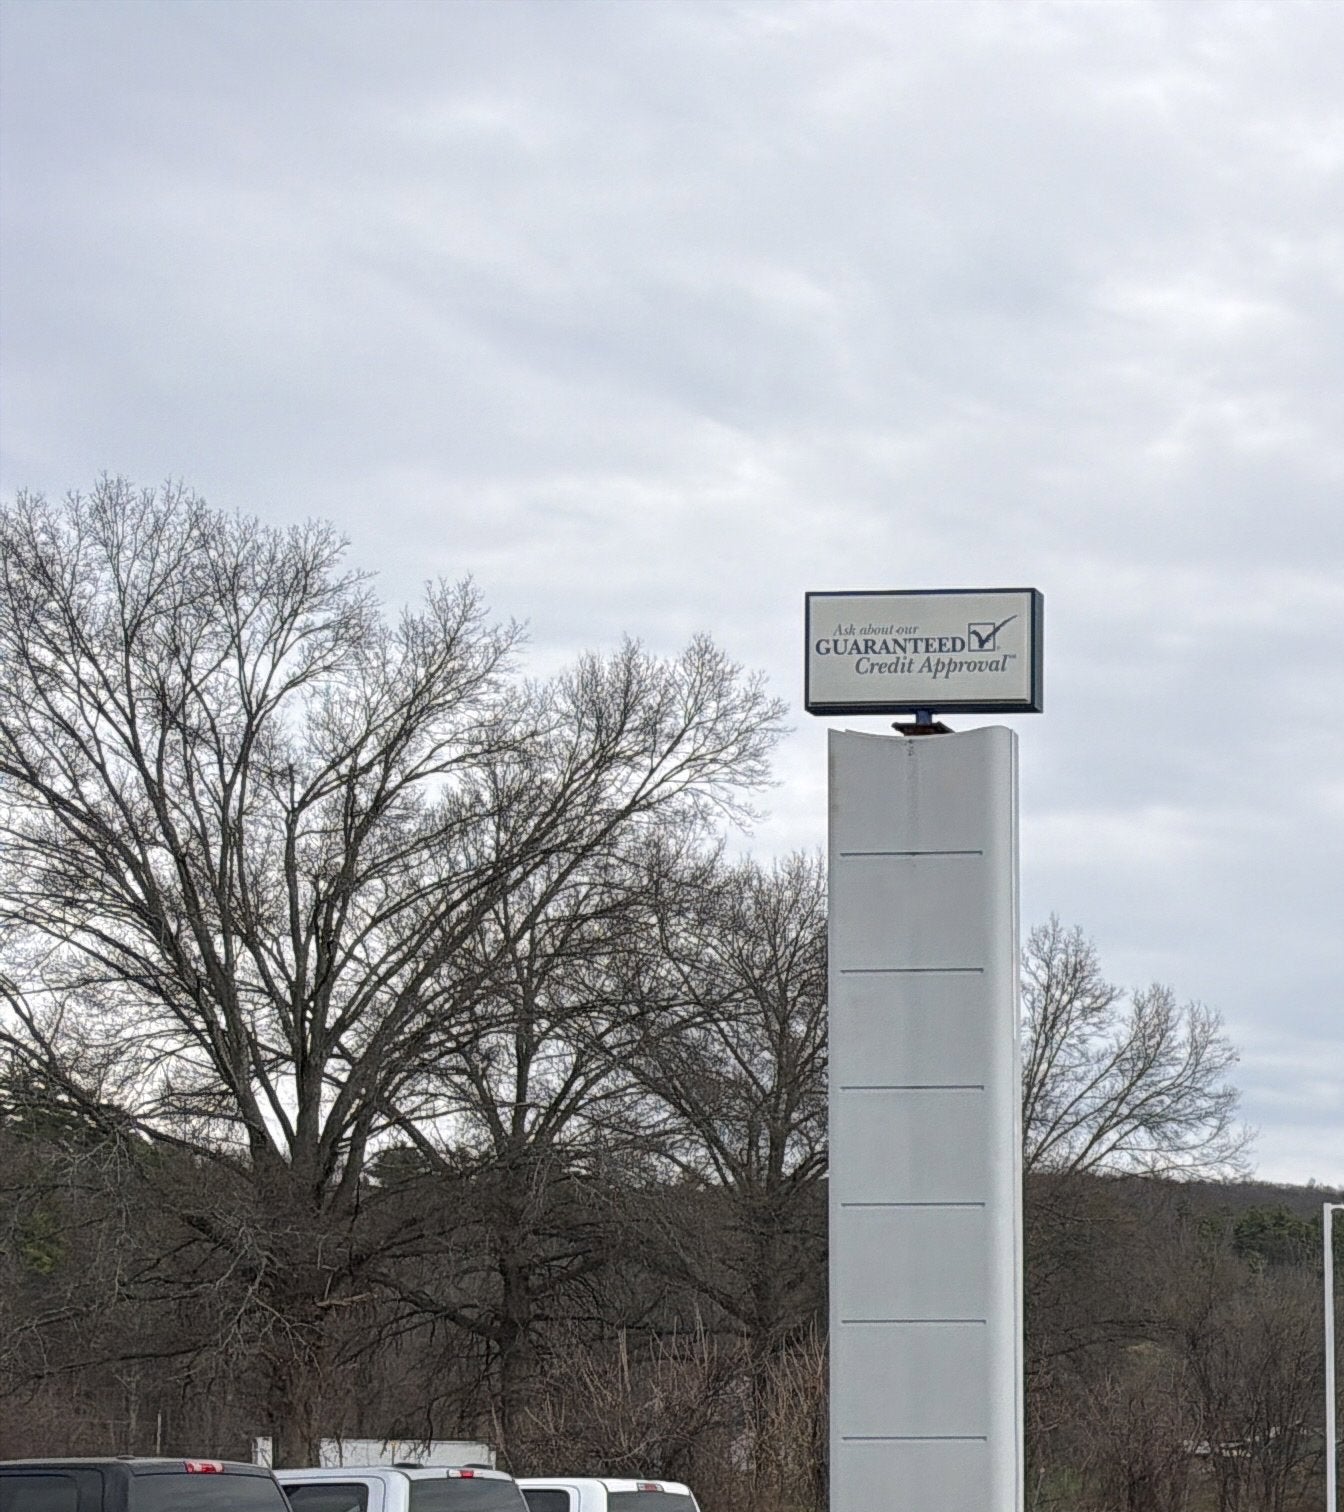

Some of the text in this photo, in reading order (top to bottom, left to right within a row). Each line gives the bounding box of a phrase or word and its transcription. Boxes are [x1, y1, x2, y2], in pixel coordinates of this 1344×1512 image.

[833, 624, 920, 636] Ask about our
[815, 636, 966, 656] GUARANTEED
[855, 654, 1008, 679] Credit Approval
